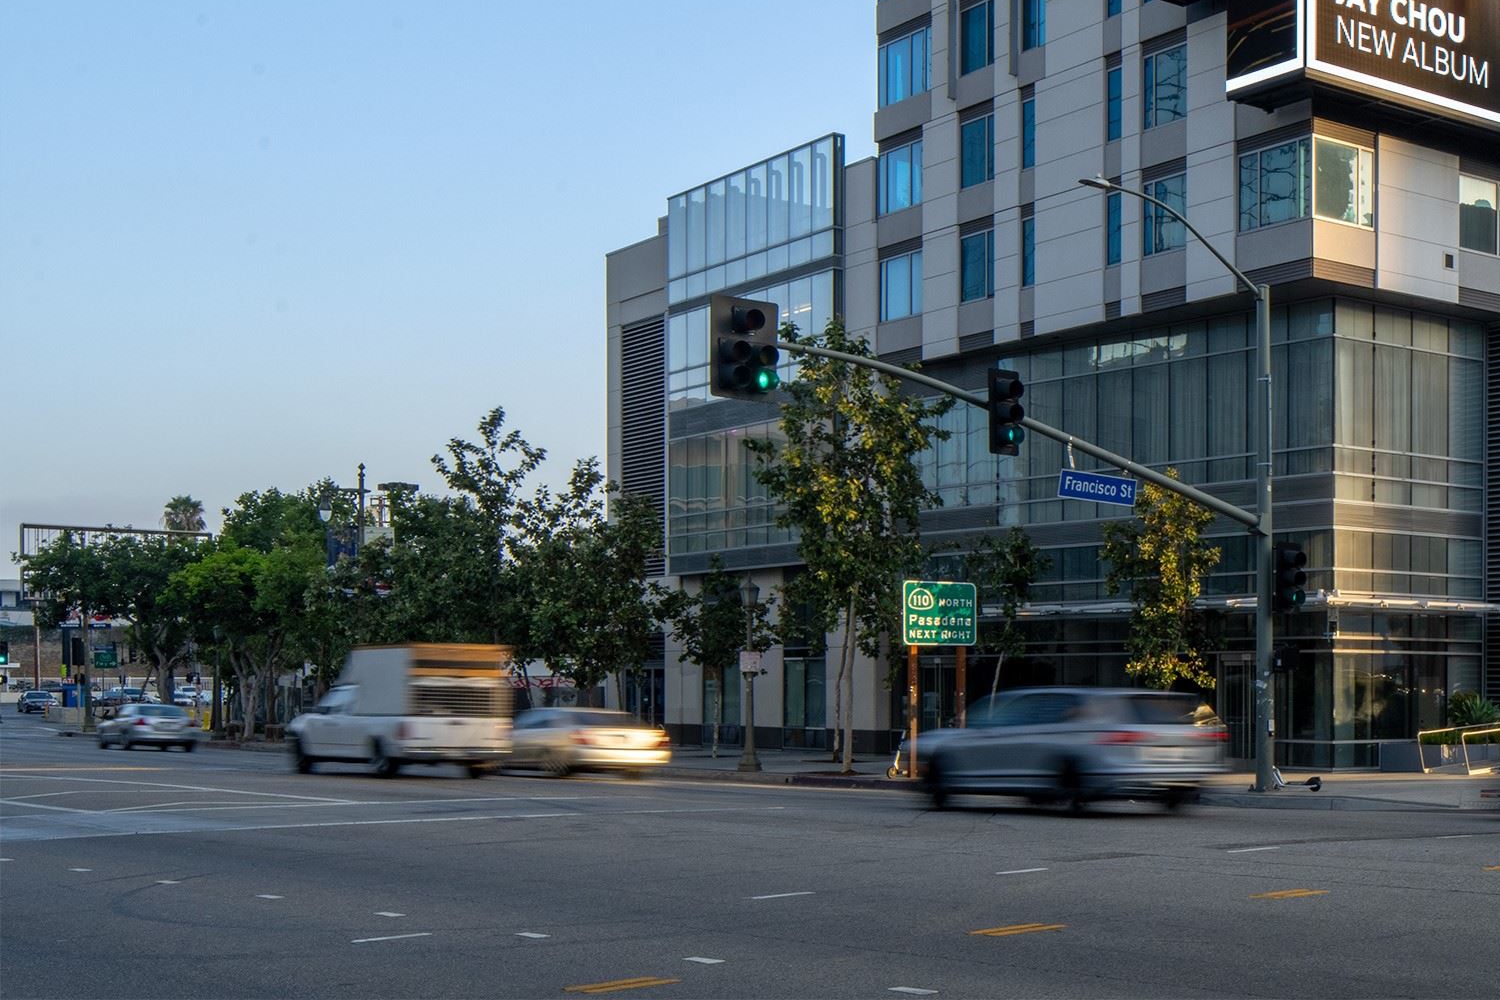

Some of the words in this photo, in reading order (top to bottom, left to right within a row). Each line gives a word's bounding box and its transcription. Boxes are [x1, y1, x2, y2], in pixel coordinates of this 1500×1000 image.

[1336, 14, 1397, 60] NEW
[1402, 37, 1489, 89] ALBUM
[1064, 475, 1117, 497] Francisco
[1120, 483, 1133, 498] St
[912, 594, 930, 607] 110
[938, 598, 973, 608] NORTH
[909, 613, 972, 627] Pasadena
[909, 629, 937, 639] NEXT
[941, 629, 971, 640] RIGHT
